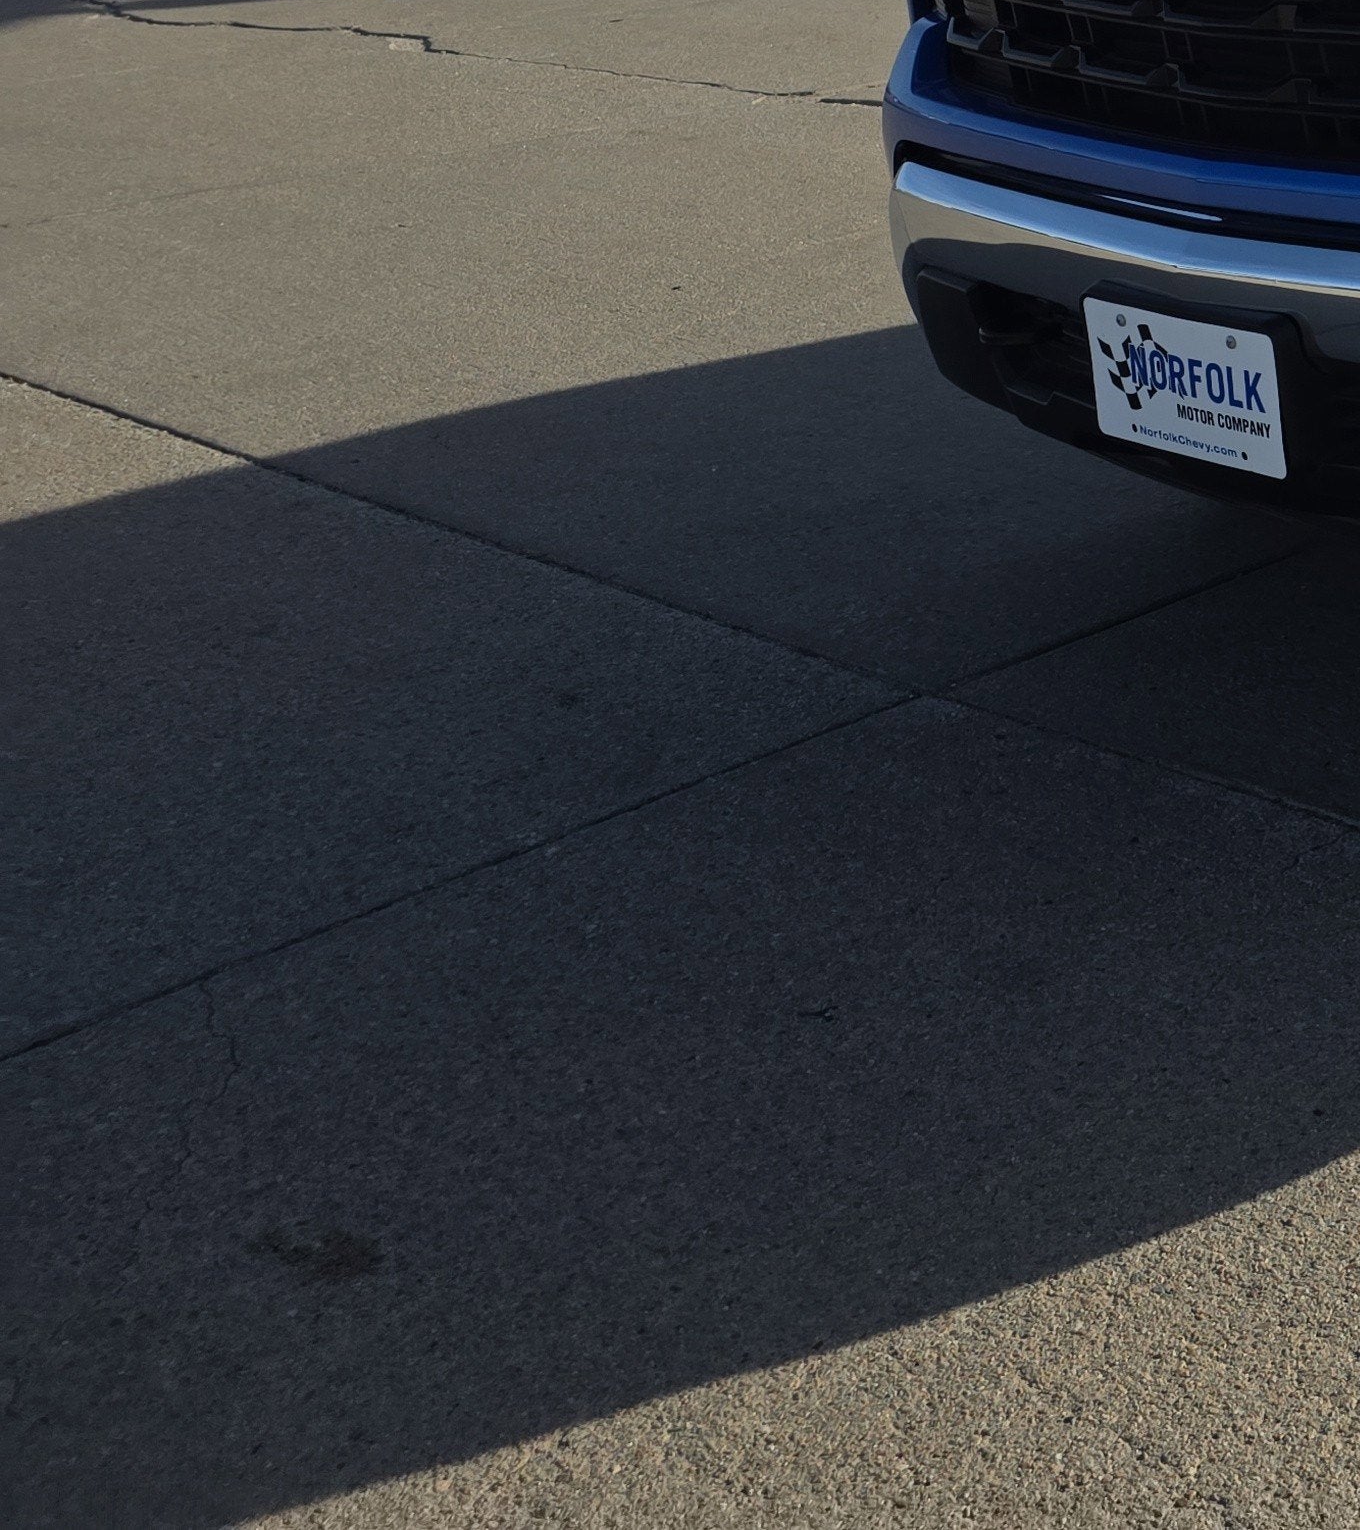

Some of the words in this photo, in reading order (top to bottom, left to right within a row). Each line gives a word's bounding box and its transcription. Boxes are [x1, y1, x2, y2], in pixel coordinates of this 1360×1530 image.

[1129, 344, 1267, 414] NORFOLK
[1176, 403, 1216, 427] MOTOR
[1217, 412, 1272, 439] COMPANY
[1139, 424, 1239, 458] NorfolkChevy.com
